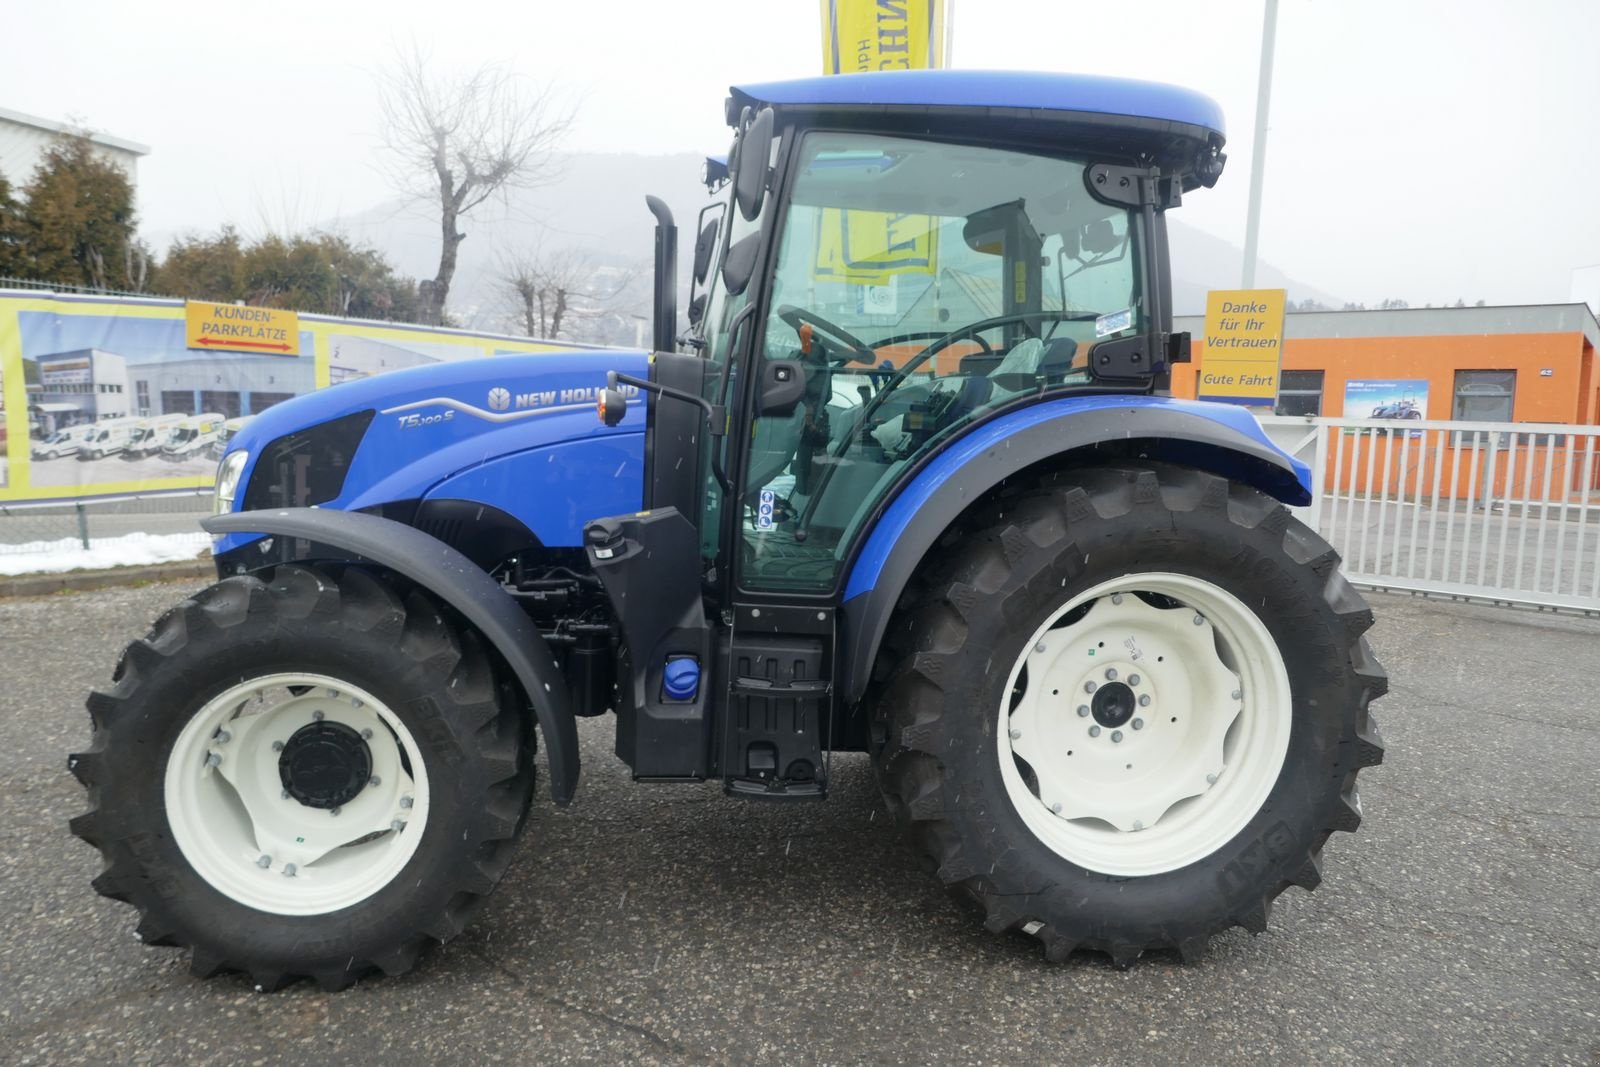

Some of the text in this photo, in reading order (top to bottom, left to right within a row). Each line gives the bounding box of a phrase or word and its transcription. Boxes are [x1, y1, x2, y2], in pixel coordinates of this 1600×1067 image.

[1222, 301, 1267, 313] Danke
[214, 306, 276, 322] KUNDEN-
[1220, 318, 1264, 330] für Ihr
[201, 322, 287, 340] PARKPLÄTZE
[1208, 336, 1277, 348] Vertrauen
[1203, 374, 1273, 386] Gute Fahrt
[516, 391, 556, 408] NEW
